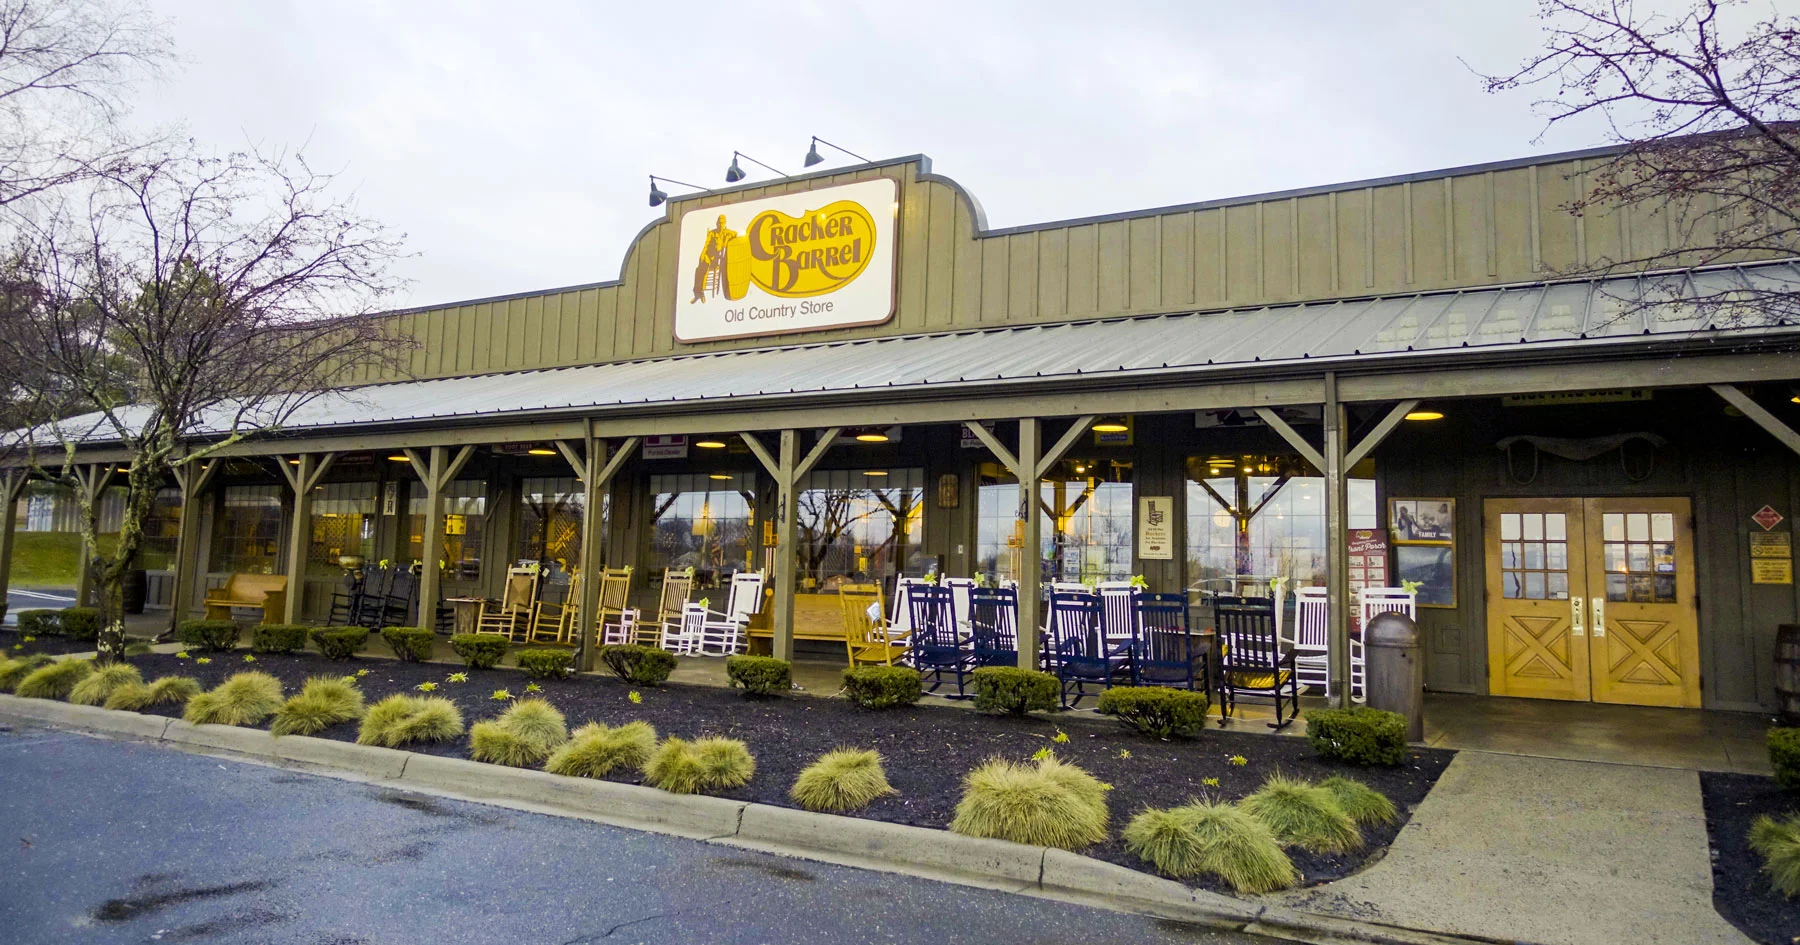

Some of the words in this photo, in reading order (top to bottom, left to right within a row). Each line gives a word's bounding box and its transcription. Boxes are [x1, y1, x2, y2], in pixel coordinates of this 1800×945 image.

[748, 212, 853, 261] Cracker
[771, 237, 862, 293] Barrel
[724, 306, 744, 323] Old
[749, 303, 797, 320] Country
[800, 300, 834, 315] Store
[1365, 542, 1387, 551] Porch
